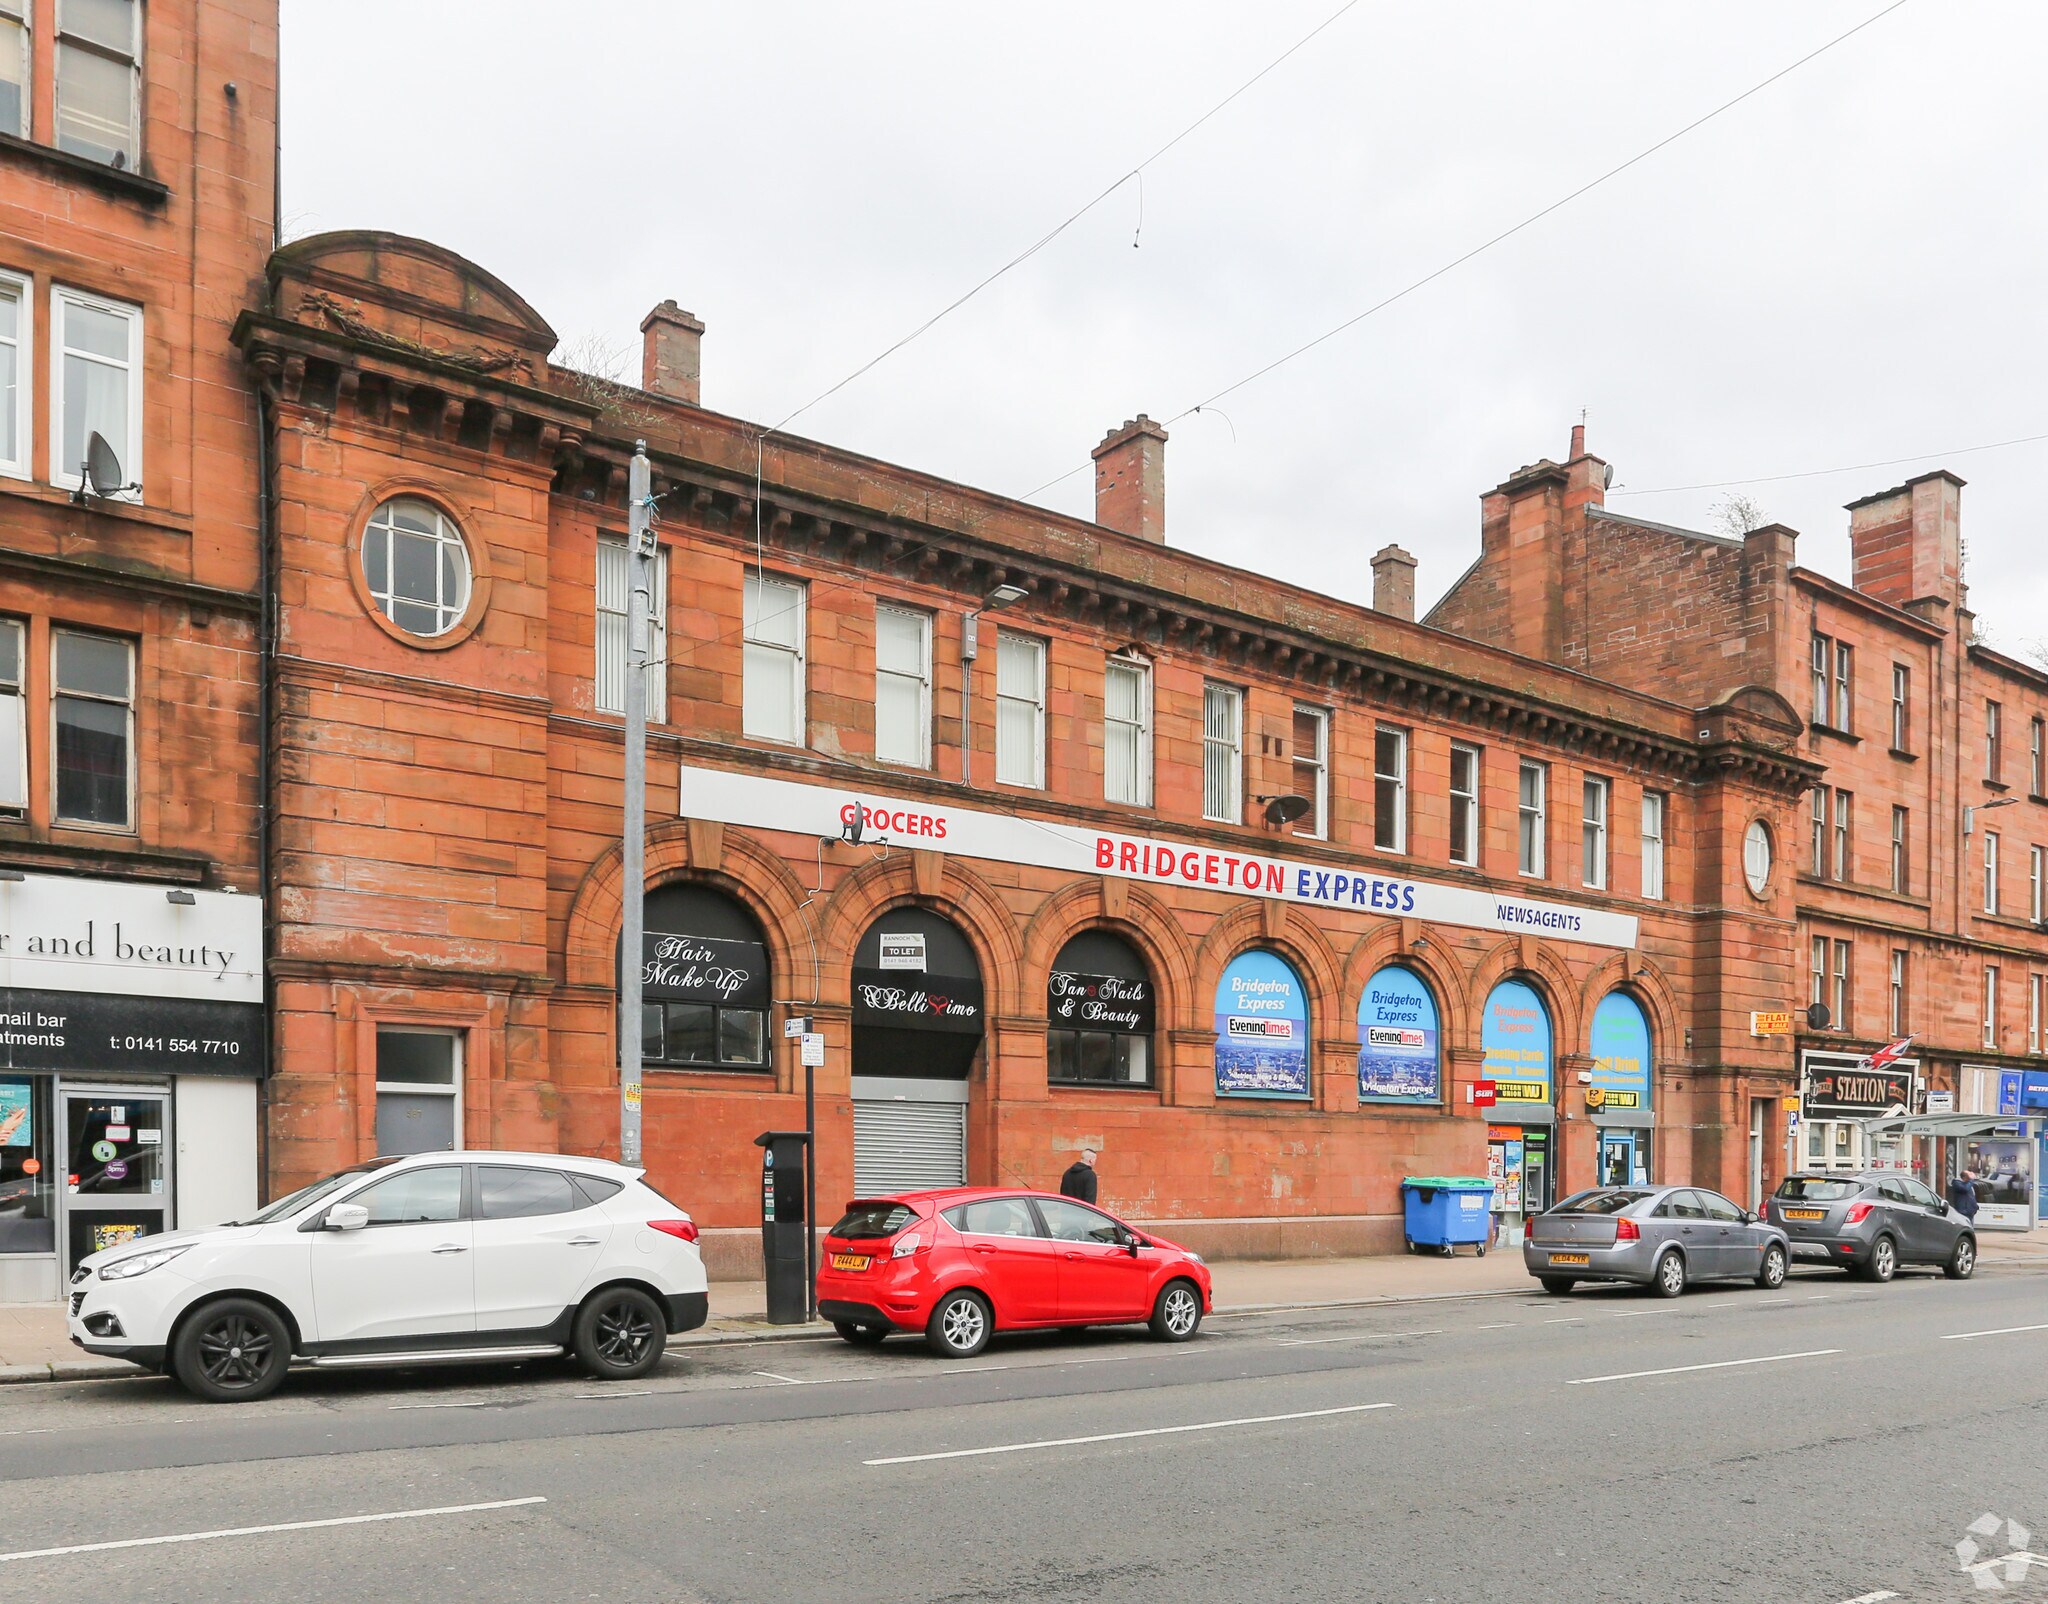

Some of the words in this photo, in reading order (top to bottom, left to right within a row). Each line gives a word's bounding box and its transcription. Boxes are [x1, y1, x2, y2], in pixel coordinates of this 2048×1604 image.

[840, 804, 947, 838] GROCERS
[1095, 838, 1284, 893] BRIDGETON
[1297, 869, 1415, 911] EXPRESS
[1497, 904, 1581, 931] NEWSAGENTS
[27, 920, 95, 957] and
[113, 922, 237, 980] beauty
[655, 937, 715, 962] Hair
[901, 948, 916, 956] LET
[641, 961, 706, 988] Make
[705, 967, 750, 999] Up
[1048, 972, 1087, 996] Tan
[1099, 979, 1145, 1000] Nails
[1231, 976, 1290, 996] Bridgeton
[1237, 994, 1286, 1013] Express
[1371, 990, 1422, 1009] Bridgeton
[0, 1012, 31, 1026] nail
[37, 1013, 67, 1028] bar
[1057, 998, 1076, 1017] &
[1081, 1001, 1141, 1029] Beauty
[1376, 1006, 1417, 1024] Express
[1494, 1003, 1538, 1021] Bridgeton
[1765, 1014, 1787, 1022] FLAT
[1498, 1019, 1534, 1034] Express
[110, 1036, 120, 1049] t:
[125, 1036, 163, 1051] 0141
[169, 1039, 198, 1053] 554
[202, 1040, 239, 1055] 7710
[1837, 1076, 1887, 1102] STATION
[836, 1255, 853, 1266] R444
